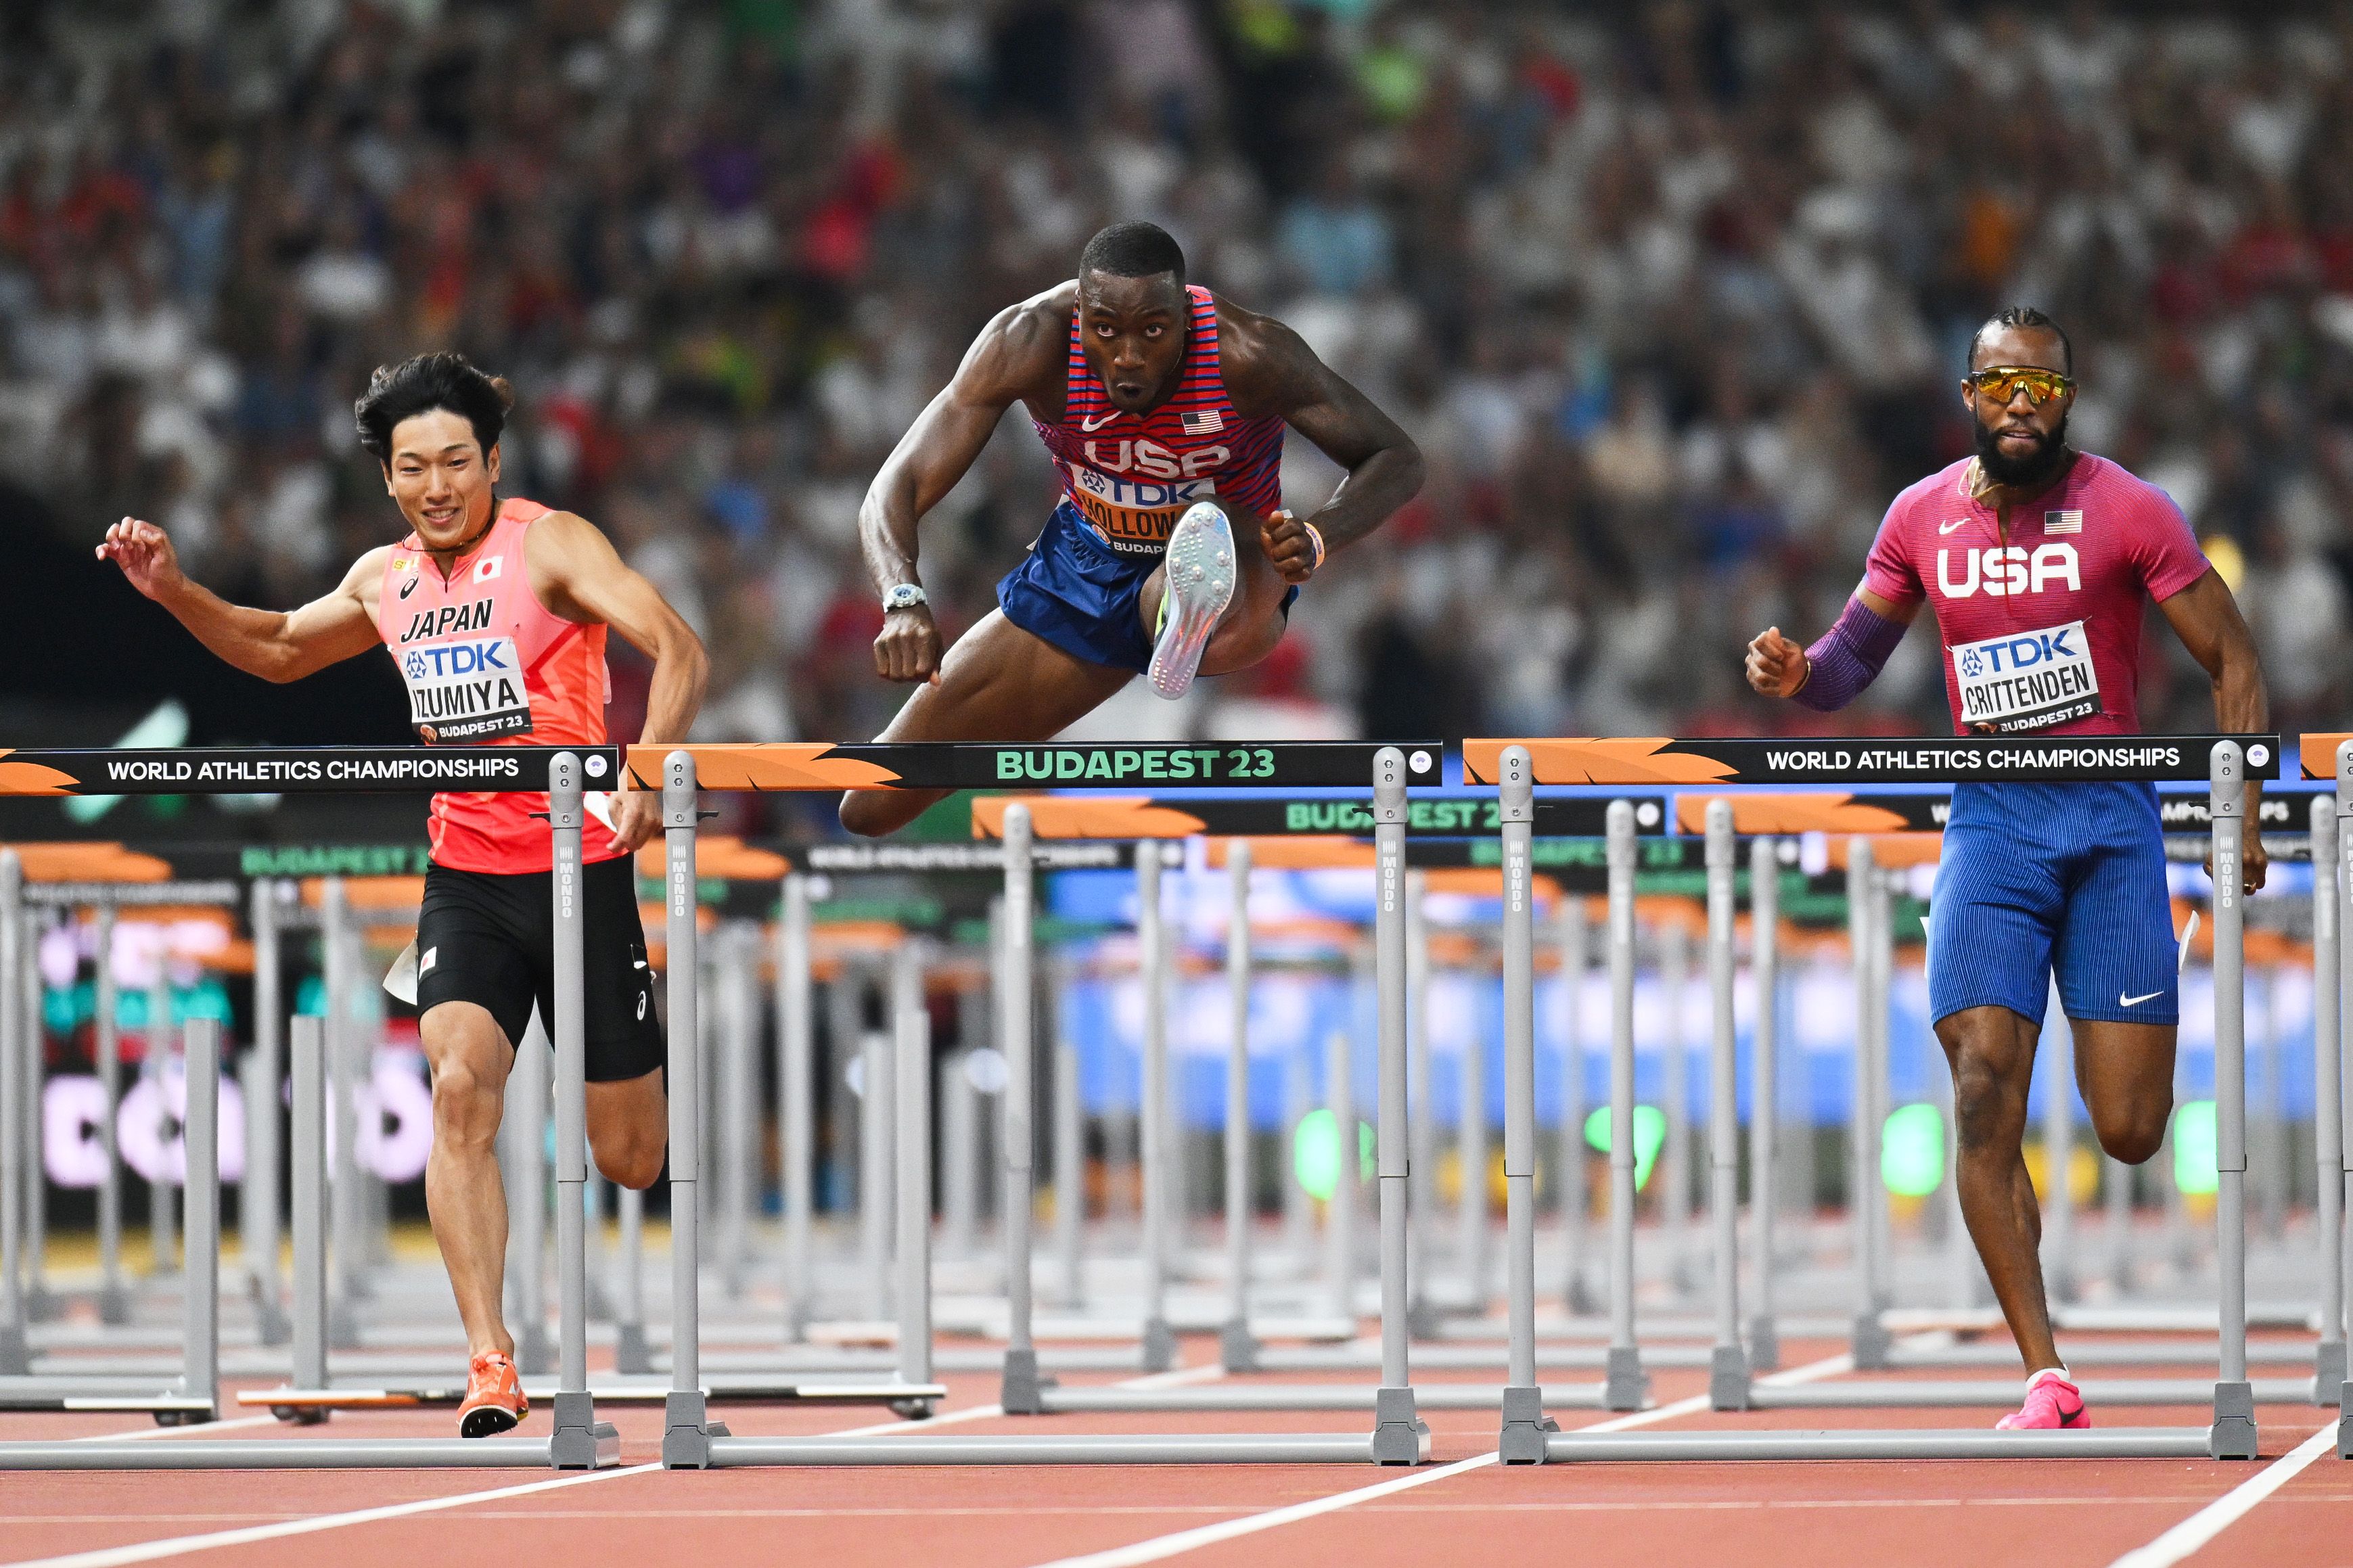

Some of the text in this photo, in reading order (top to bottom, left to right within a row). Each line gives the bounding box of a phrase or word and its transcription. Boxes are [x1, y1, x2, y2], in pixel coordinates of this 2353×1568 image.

[1107, 476, 1200, 506] TDK
[1082, 494, 1176, 537] HOLLOW
[1938, 543, 2081, 598] USA
[401, 599, 493, 643] JAPAN
[425, 641, 509, 676] TDK
[1980, 629, 2077, 672] TDK
[412, 678, 520, 718] IZUMIYA
[1965, 662, 2091, 716] CRITTENDEN
[439, 715, 524, 738] BUDAPEST 23
[2001, 702, 2093, 733] BUDAPEST 23
[107, 758, 520, 781] WORLD ATHLETICS CHAMPIONSHIPS
[997, 749, 1276, 779] BUDAPEST 23
[1766, 747, 2181, 770] WORLD ATHLETICS CHAMPIONSHIPS
[559, 862, 574, 918] MONDO
[672, 861, 687, 917] MONDO
[1382, 856, 1396, 913] MONDO
[1509, 856, 1524, 913] MONDO
[2220, 852, 2235, 908] MONDO
